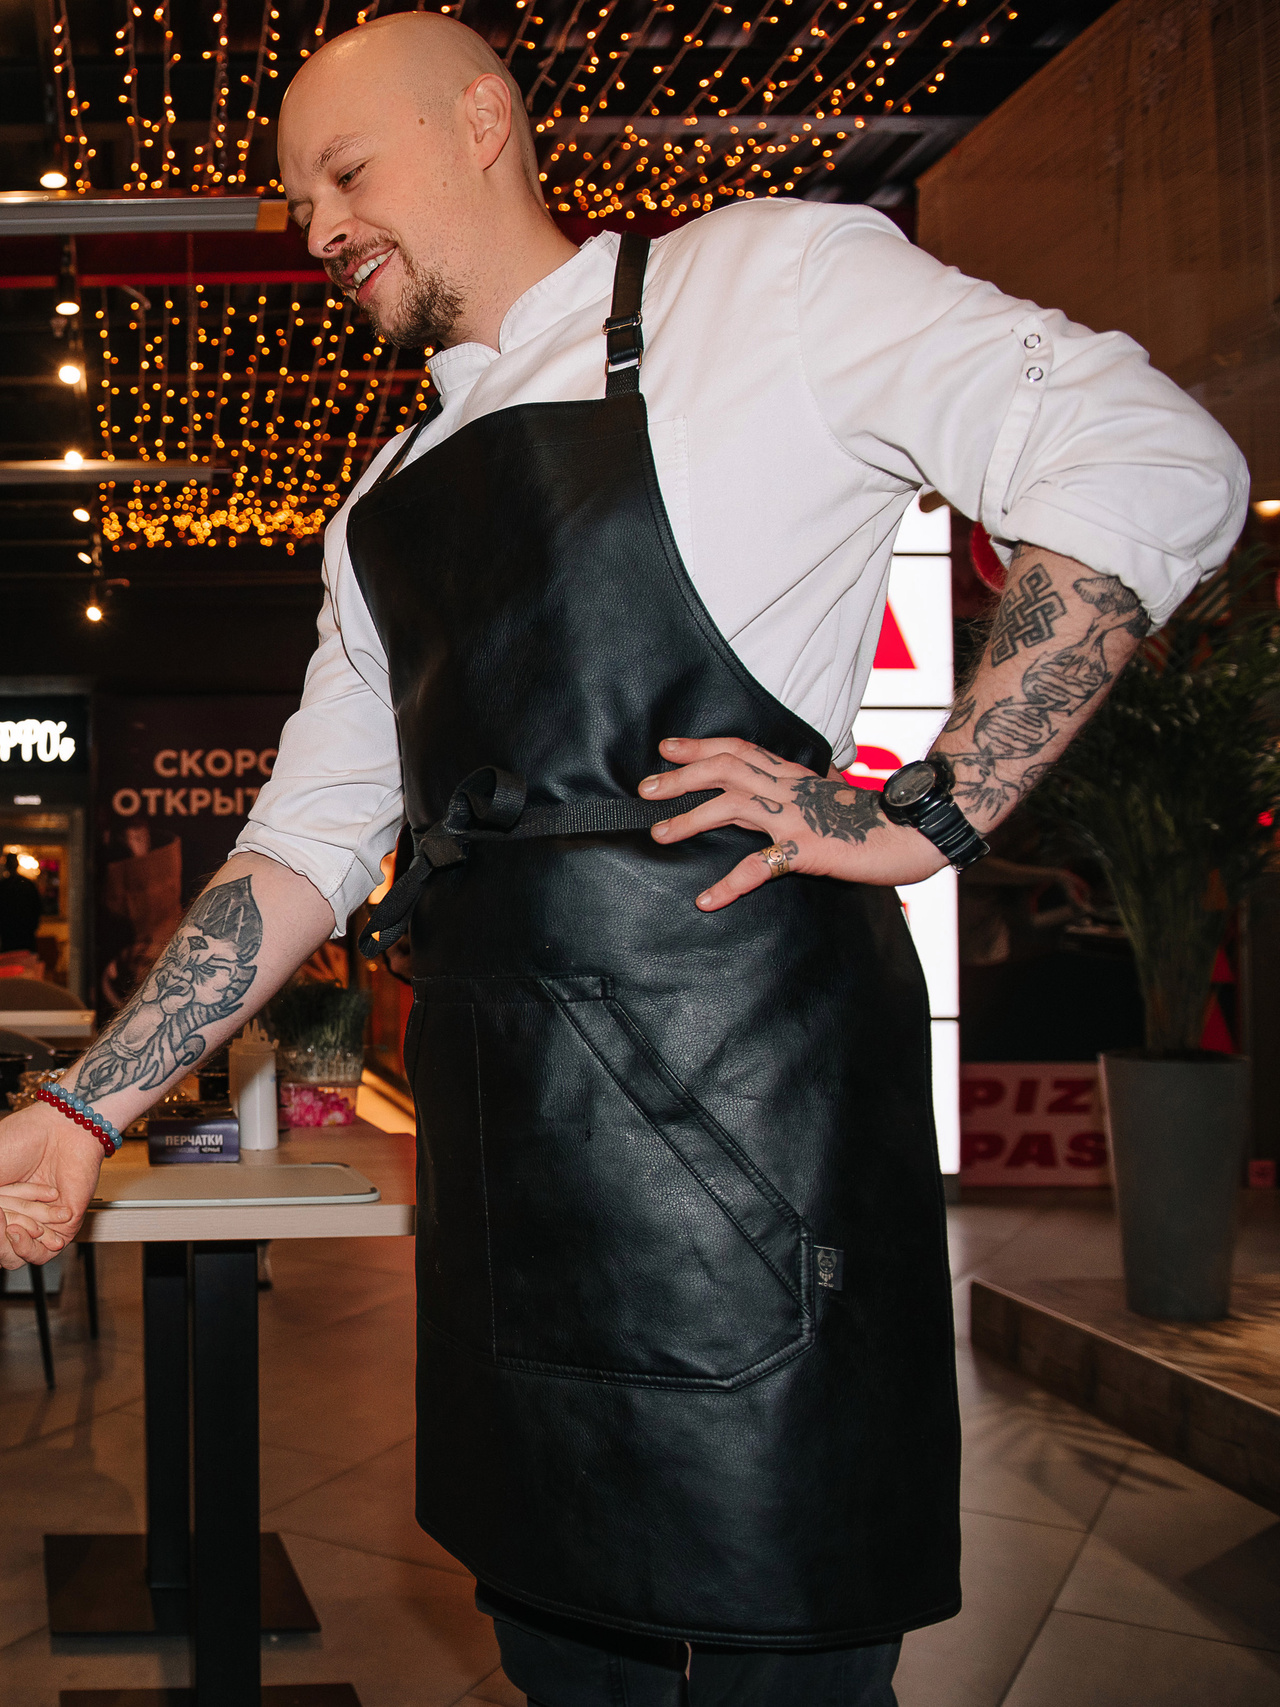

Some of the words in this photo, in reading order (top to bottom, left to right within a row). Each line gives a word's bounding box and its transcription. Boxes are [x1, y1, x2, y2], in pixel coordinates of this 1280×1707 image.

[111, 787, 262, 817] ОТКРЫ
[960, 1078, 1097, 1115] PIZ
[166, 1135, 223, 1146] ПЕРЧАТКИ
[960, 1131, 1108, 1170] PAS
